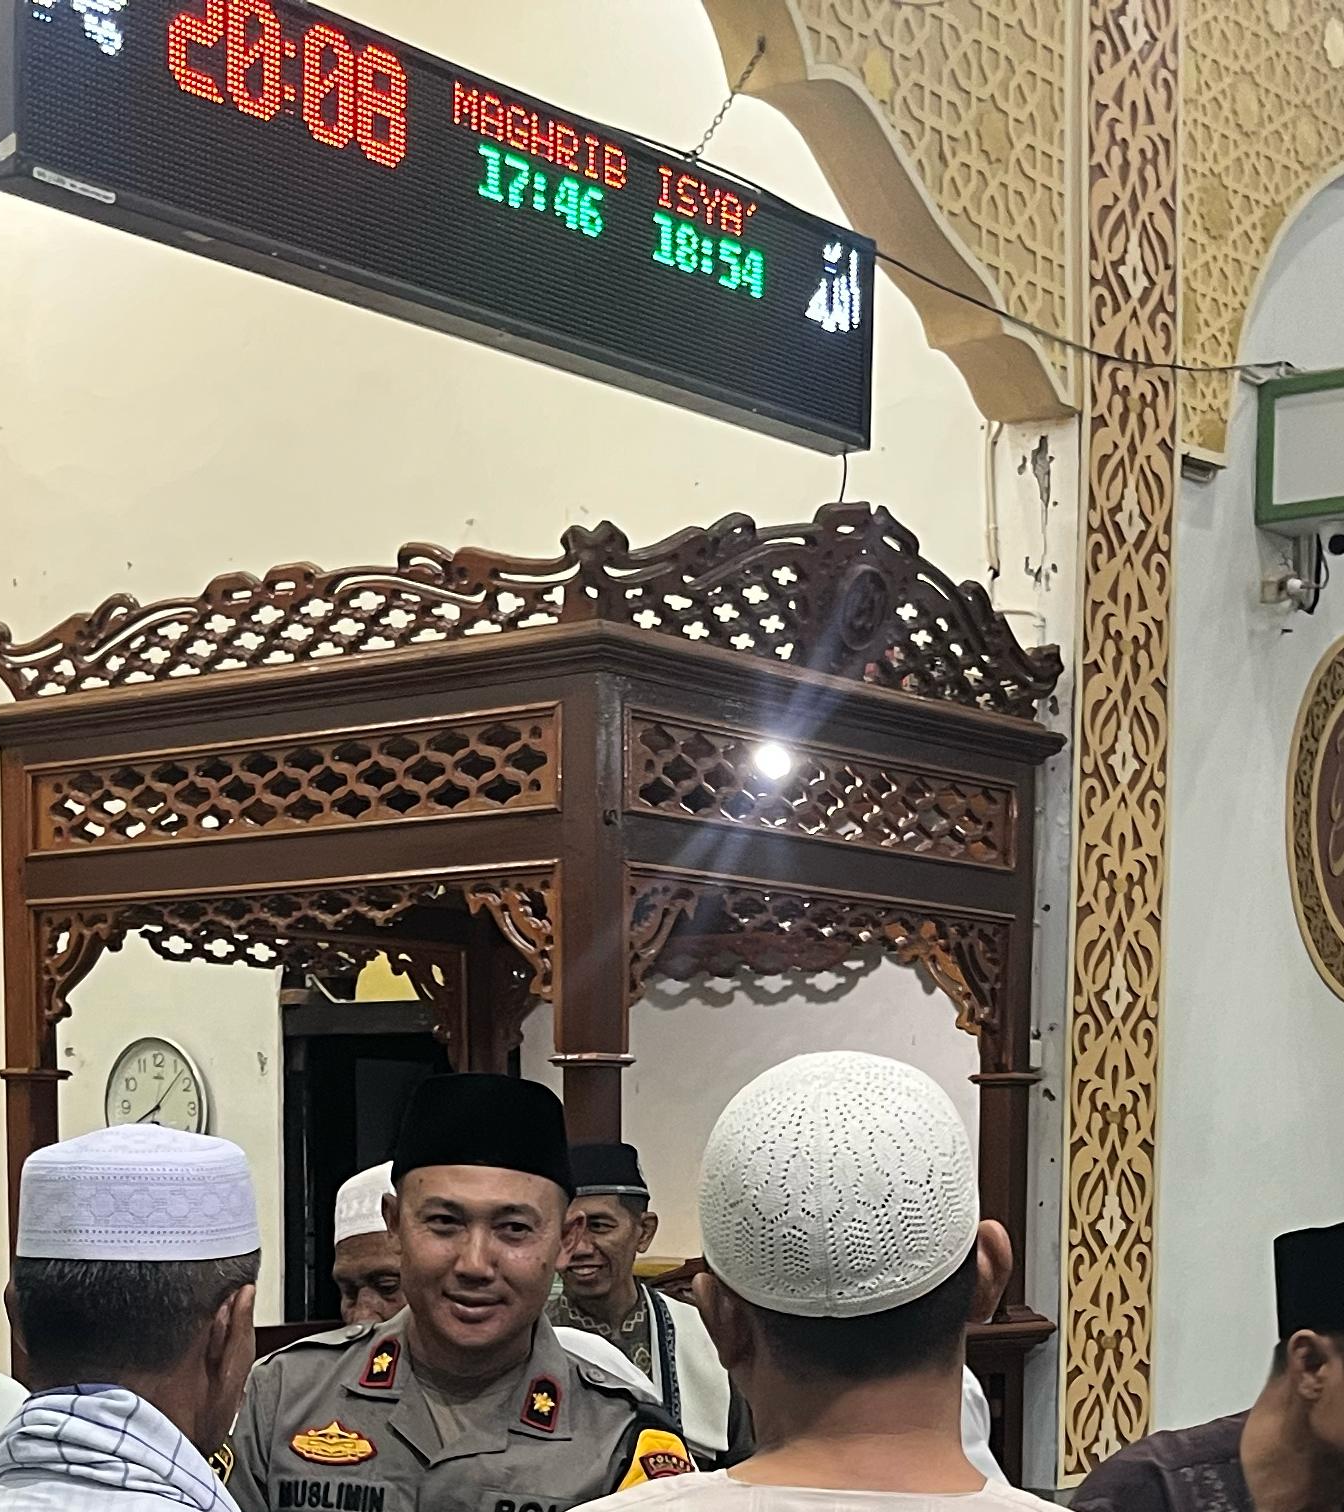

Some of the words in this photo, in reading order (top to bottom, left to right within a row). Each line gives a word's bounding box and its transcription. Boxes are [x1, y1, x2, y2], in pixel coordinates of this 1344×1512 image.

[167, 0, 408, 169] 20:08
[453, 79, 629, 191] MAGHRIB
[477, 142, 607, 239] 17:46
[653, 209, 766, 300] 18:54
